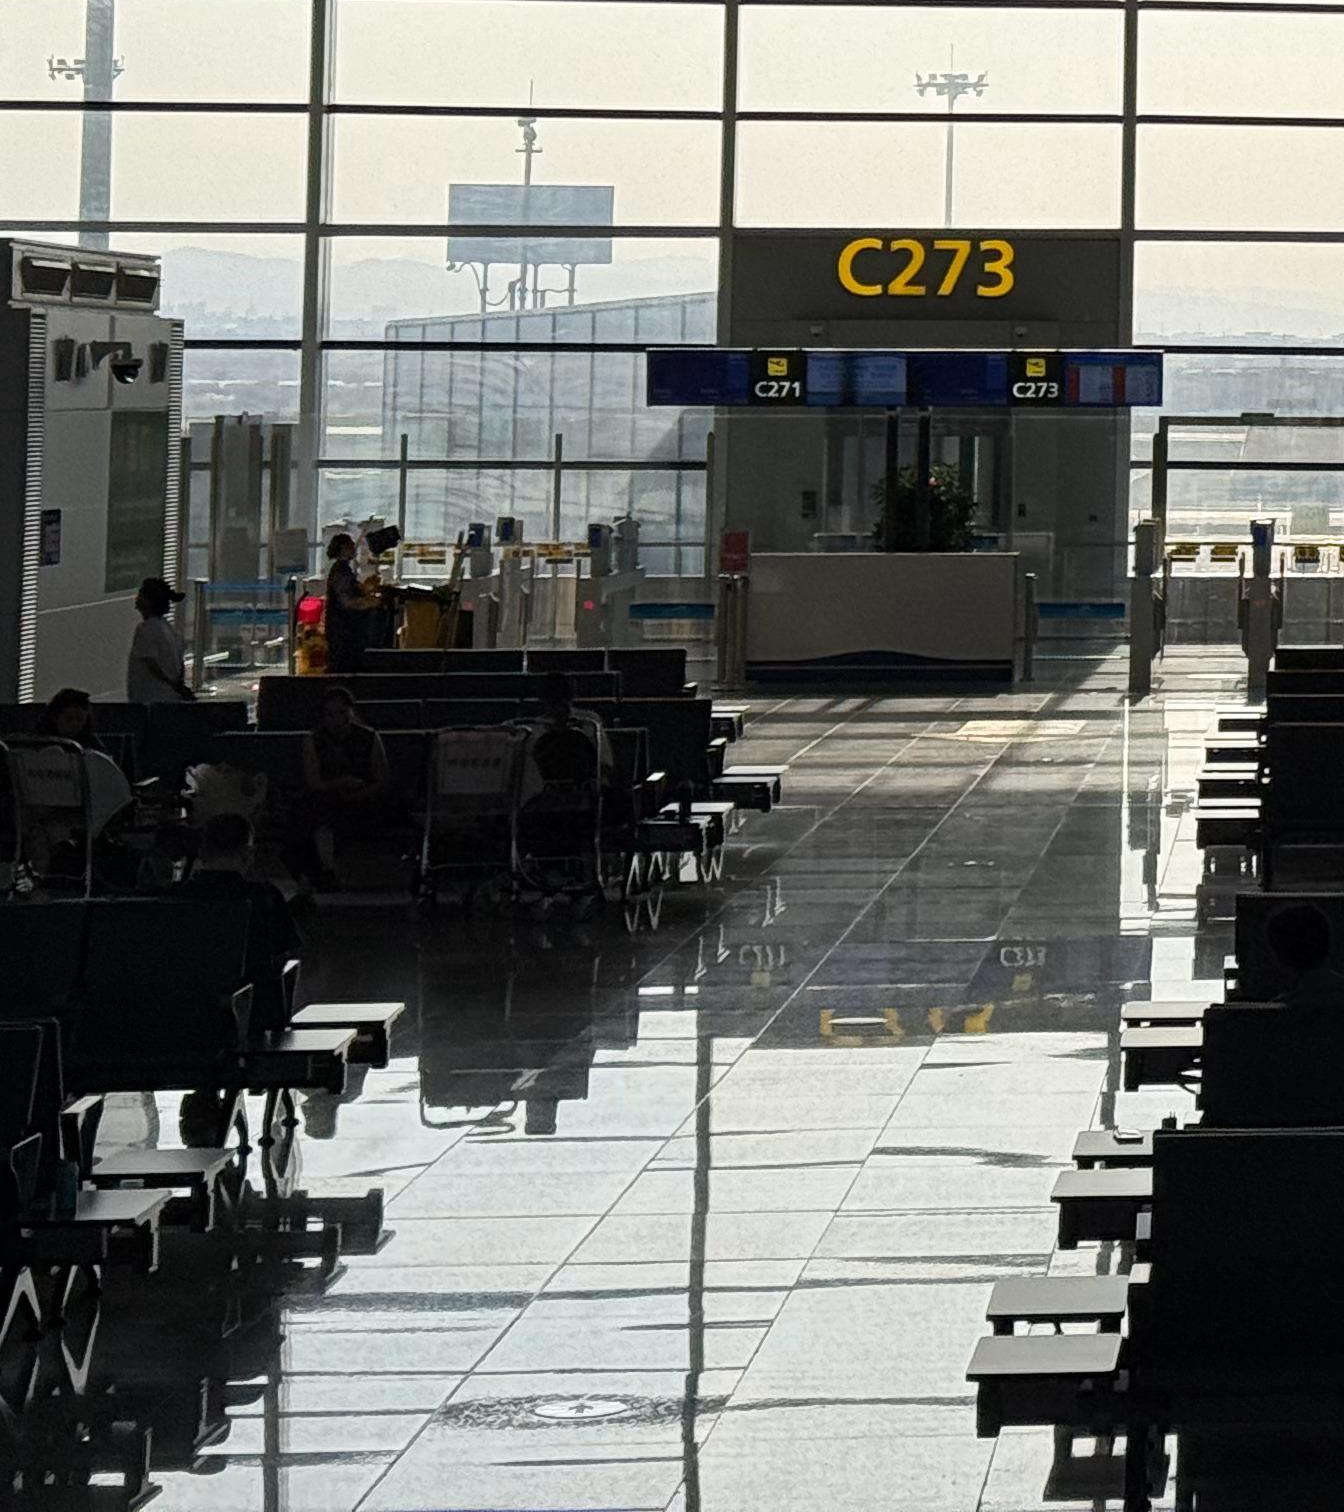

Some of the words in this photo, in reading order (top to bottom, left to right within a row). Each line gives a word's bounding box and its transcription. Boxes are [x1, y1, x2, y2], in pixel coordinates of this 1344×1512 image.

[837, 236, 1016, 298] C273
[754, 381, 801, 398] C271
[1012, 382, 1059, 399] C273
